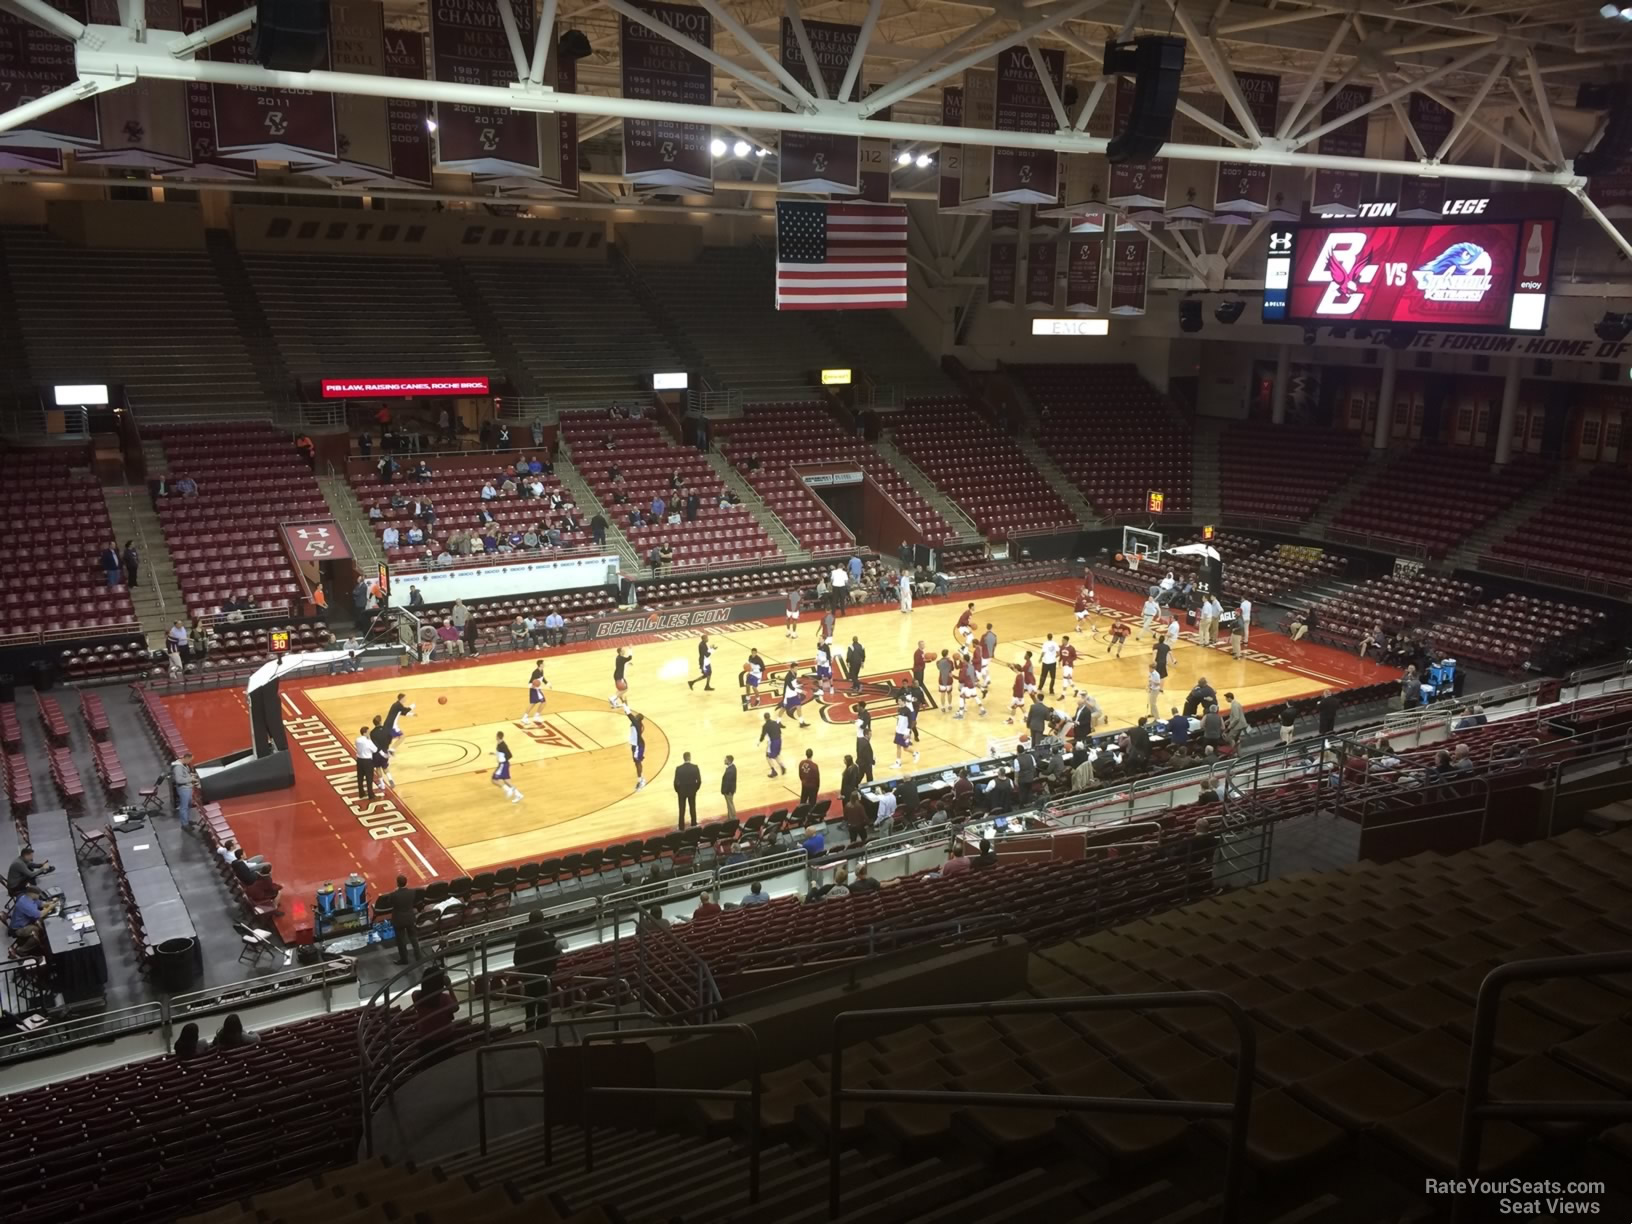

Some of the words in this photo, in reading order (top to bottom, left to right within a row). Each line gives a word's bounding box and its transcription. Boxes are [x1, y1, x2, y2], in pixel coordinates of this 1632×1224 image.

[438, 8, 531, 30] CHAMPINS
[1010, 52, 1052, 71] NCA
[0, 68, 64, 80] URNAMENT
[1240, 79, 1273, 94] ROZEN
[257, 97, 290, 107] 2011
[1246, 91, 1265, 102] OUR
[474, 116, 504, 125] 2012
[1321, 202, 1397, 218] TON
[1385, 263, 1407, 286] VS
[1521, 281, 1542, 290] enjoy
[1441, 335, 1516, 351] FORUM
[1526, 341, 1593, 358] HOME
[1594, 342, 1632, 358] OF
[1150, 501, 1160, 511] 30
[273, 640, 286, 650] 30
[282, 715, 358, 771] COLLEGE
